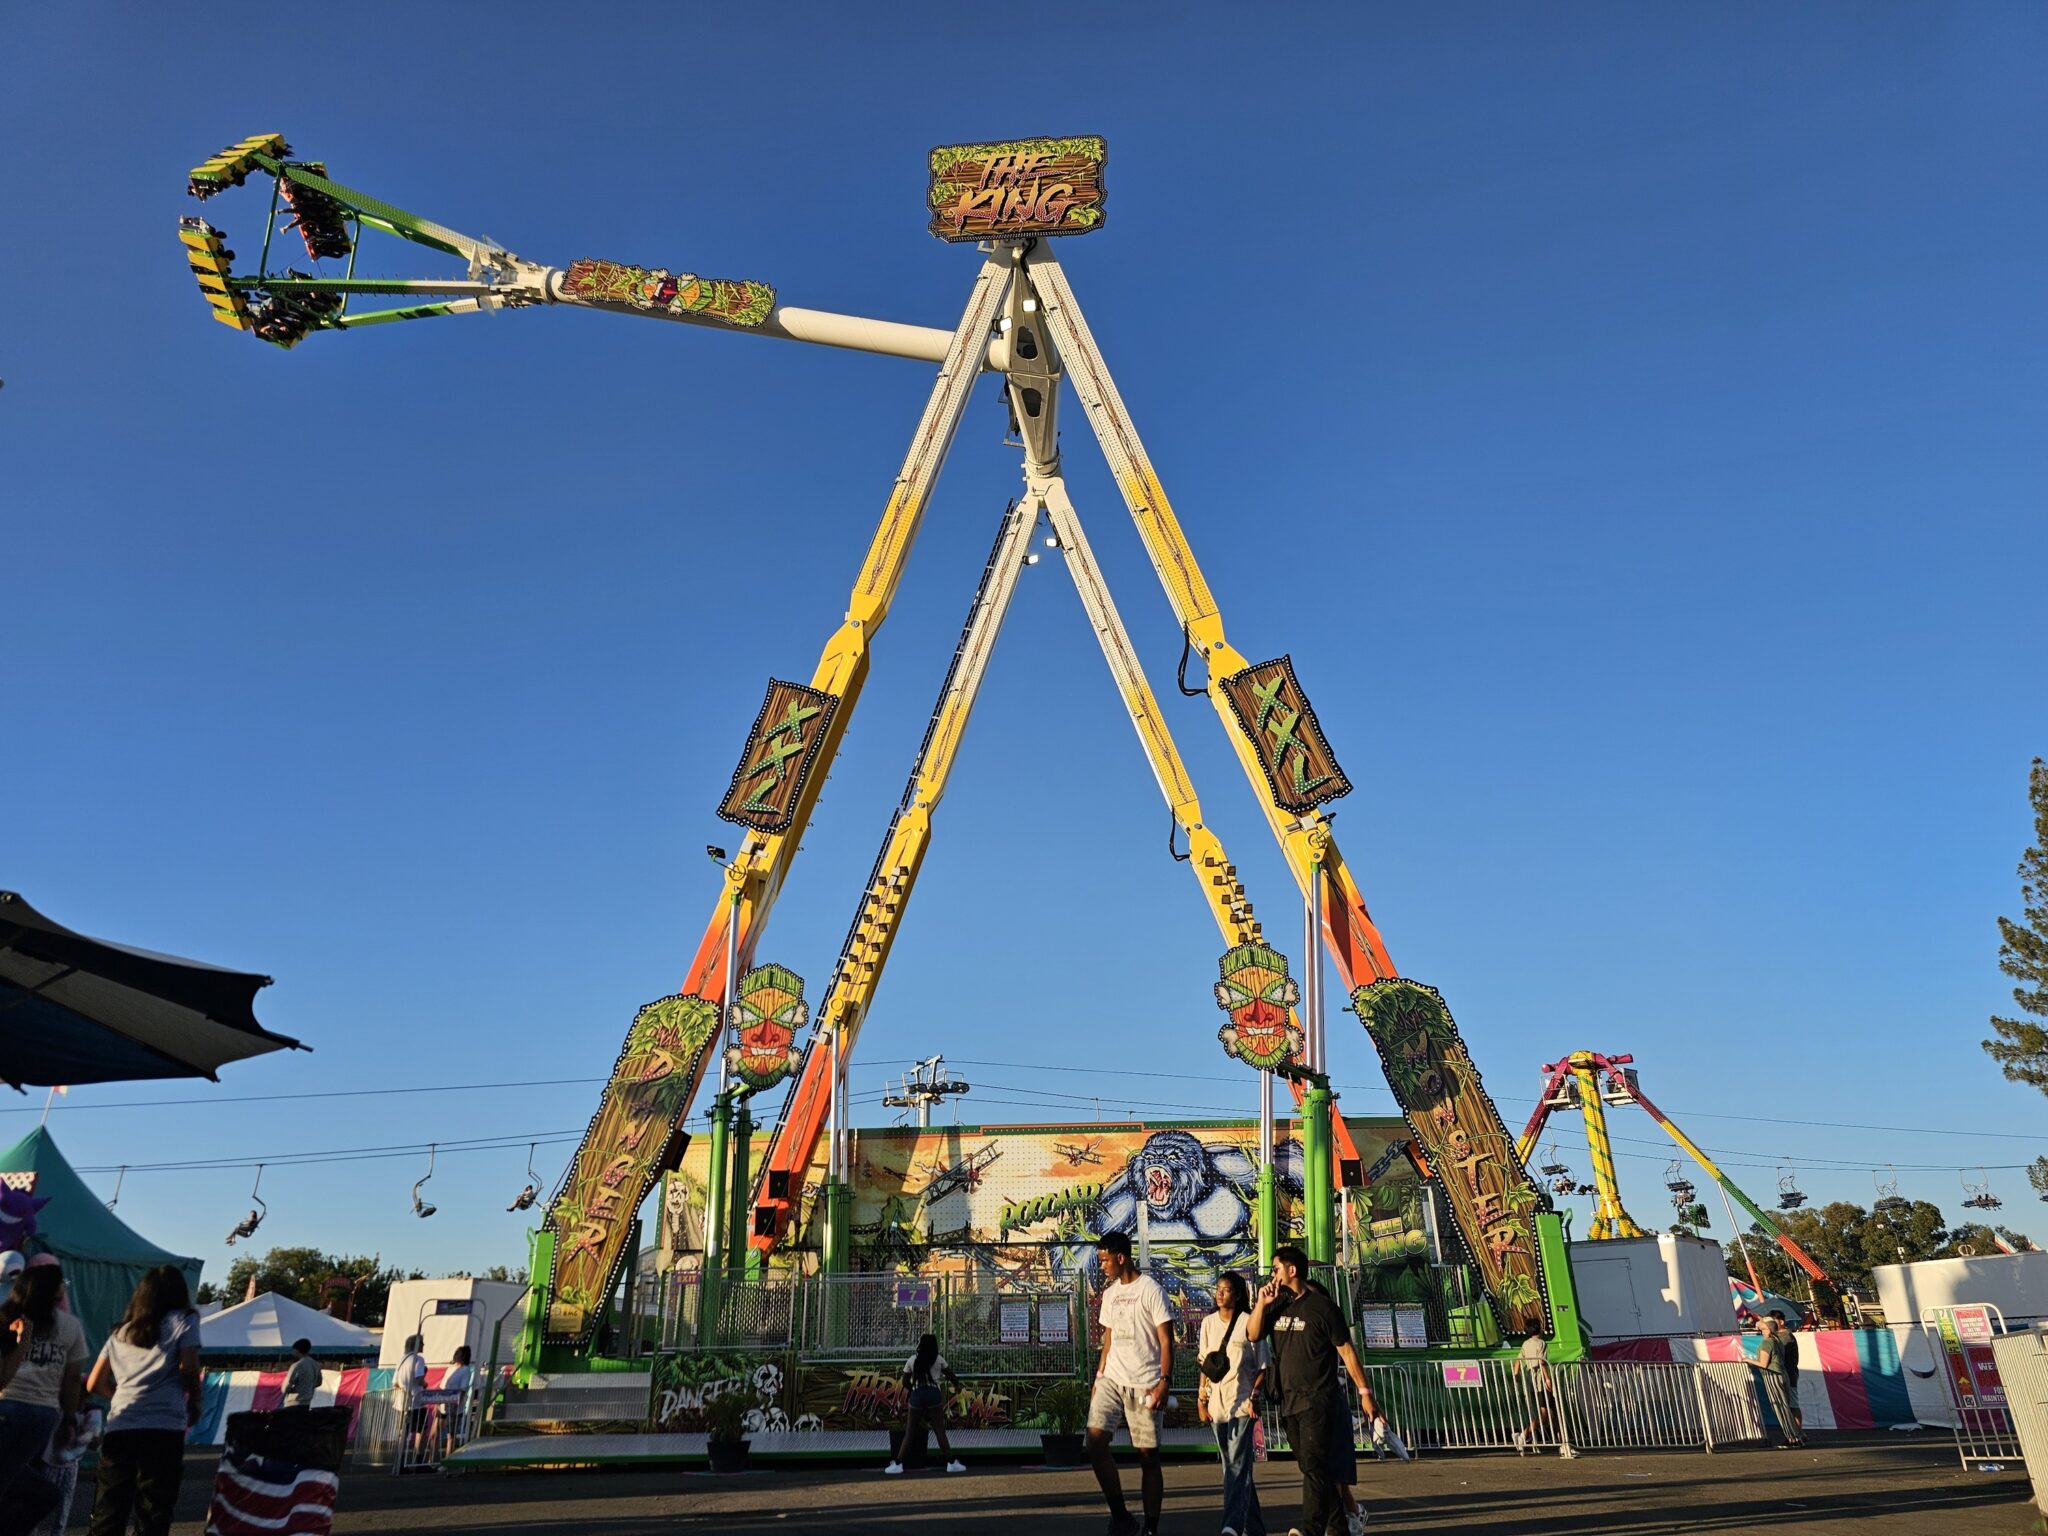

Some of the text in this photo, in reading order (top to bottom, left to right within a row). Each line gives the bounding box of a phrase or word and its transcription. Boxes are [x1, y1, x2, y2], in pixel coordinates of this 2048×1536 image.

[976, 151, 1070, 191] THE
[948, 175, 1081, 233] KING
[739, 697, 822, 815] XXL
[1251, 674, 1337, 796] XXL
[566, 1048, 674, 1264] DANGER
[1403, 1030, 1530, 1273] MONSTER
[1360, 1230, 1427, 1266] KING
[1370, 1217, 1403, 1238] THE
[676, 1274, 698, 1284] EXIT
[1456, 1367, 1467, 1380] 7
